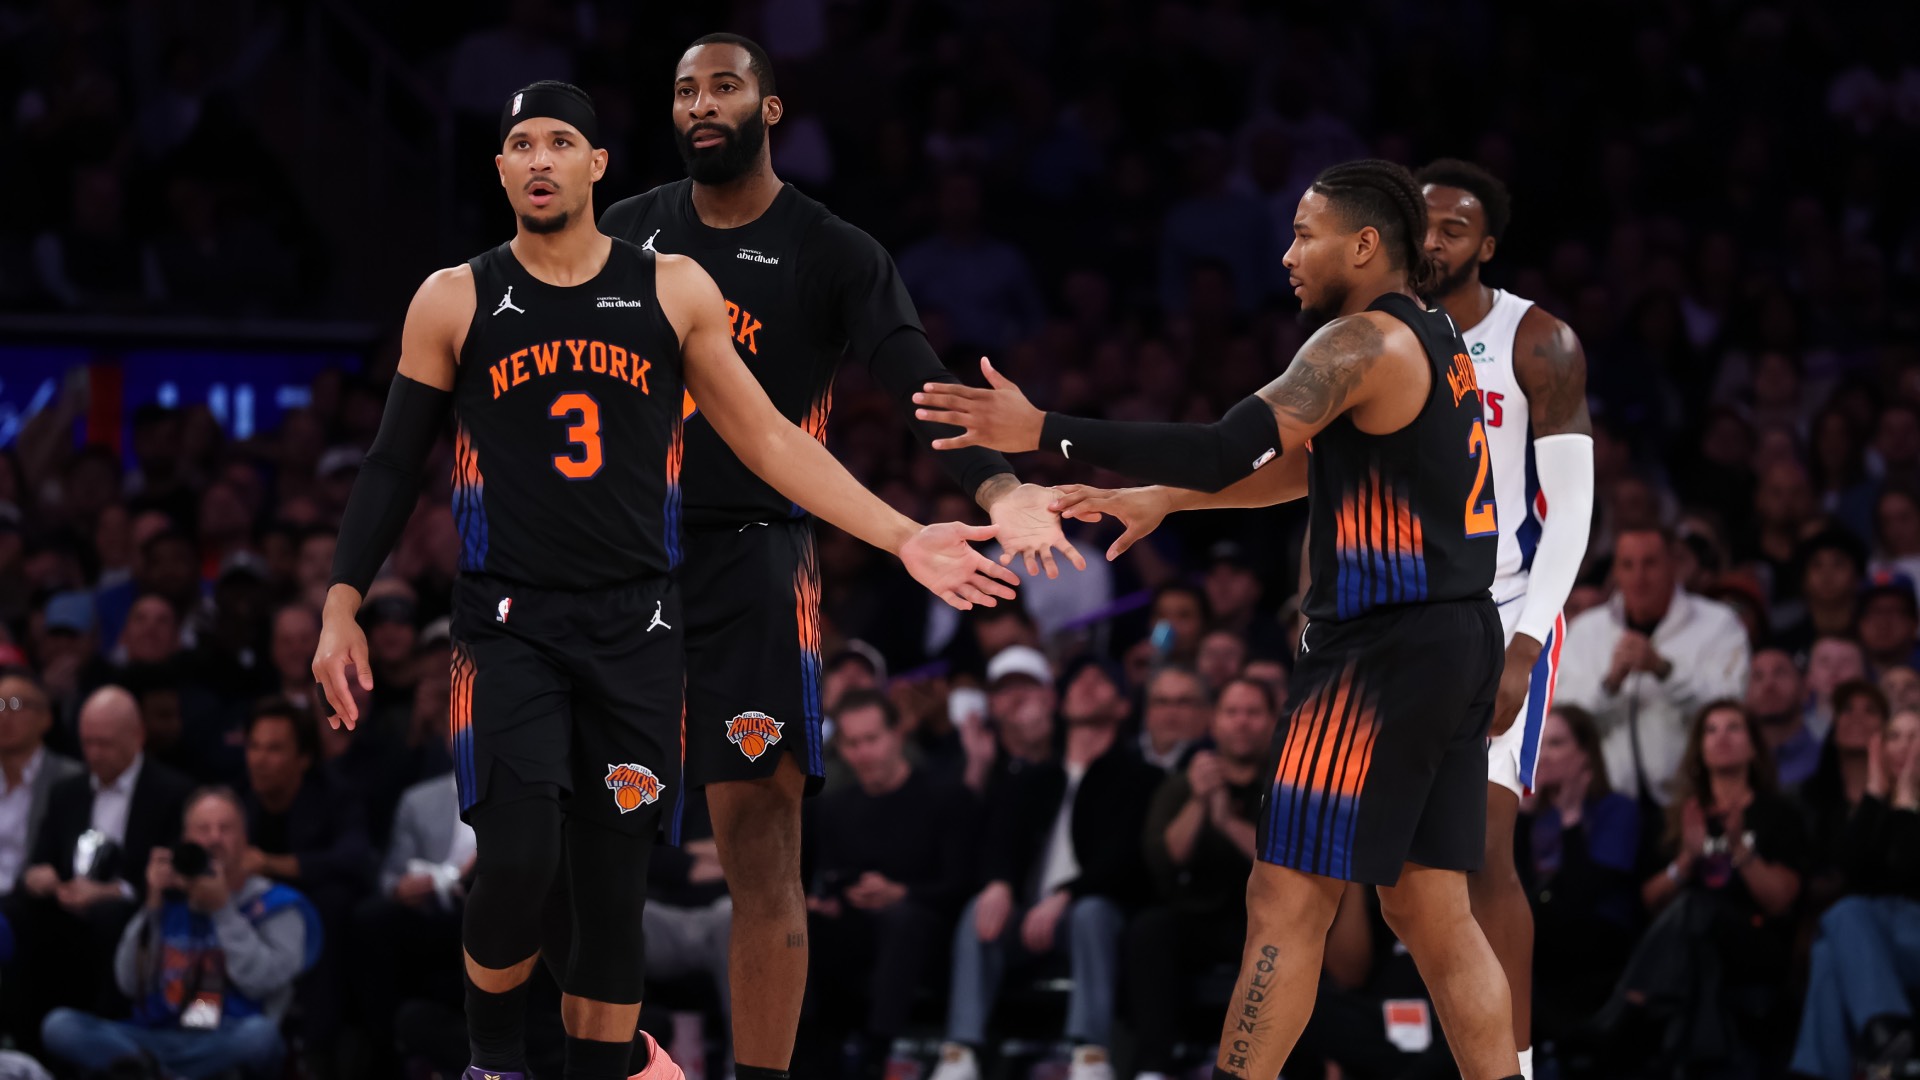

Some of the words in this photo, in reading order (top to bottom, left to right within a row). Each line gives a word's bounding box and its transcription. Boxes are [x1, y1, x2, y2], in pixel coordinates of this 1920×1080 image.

[736, 252, 753, 261] abu
[754, 254, 779, 265] dhabi
[597, 300, 614, 308] abu
[615, 300, 641, 308] dhabi
[489, 340, 562, 400] NEW
[565, 339, 652, 396] YORK
[548, 390, 605, 482] 3
[729, 717, 780, 738] KNICKS
[606, 765, 657, 799] KNICKS
[1237, 944, 1279, 1034] GOLDEN
